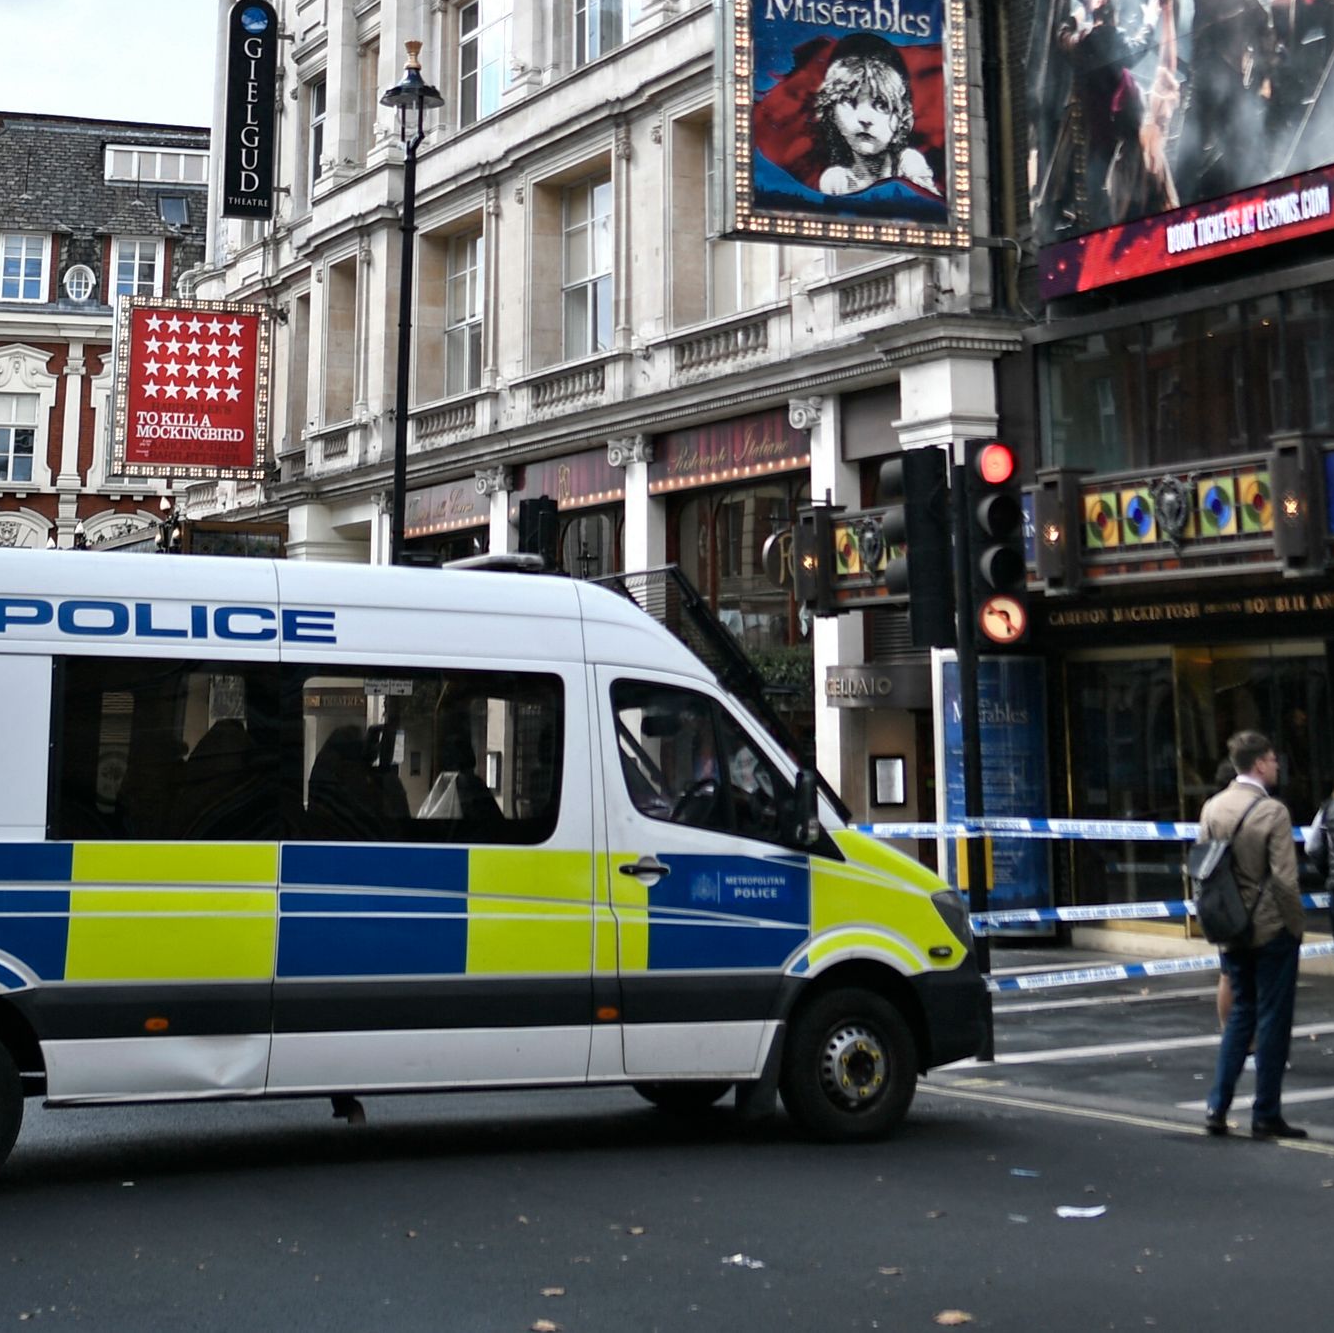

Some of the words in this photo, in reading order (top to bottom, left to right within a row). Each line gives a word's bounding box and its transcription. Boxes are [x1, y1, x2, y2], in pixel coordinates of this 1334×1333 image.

[239, 37, 263, 193] GIELGUD
[228, 196, 269, 209] THEATRE
[1167, 222, 1197, 254] BOOK
[1197, 207, 1241, 247] TICKETS
[1241, 205, 1256, 235] AT
[1256, 185, 1330, 231] LESMIS.COM
[136, 411, 158, 425] TO
[160, 413, 198, 427] KILL
[200, 414, 212, 427] A
[135, 425, 245, 442] MOCKINGBIRD
[1113, 602, 1201, 623] MACKINTOSH
[725, 875, 786, 887] METROPOLITAN
[734, 887, 779, 899] POLICE
